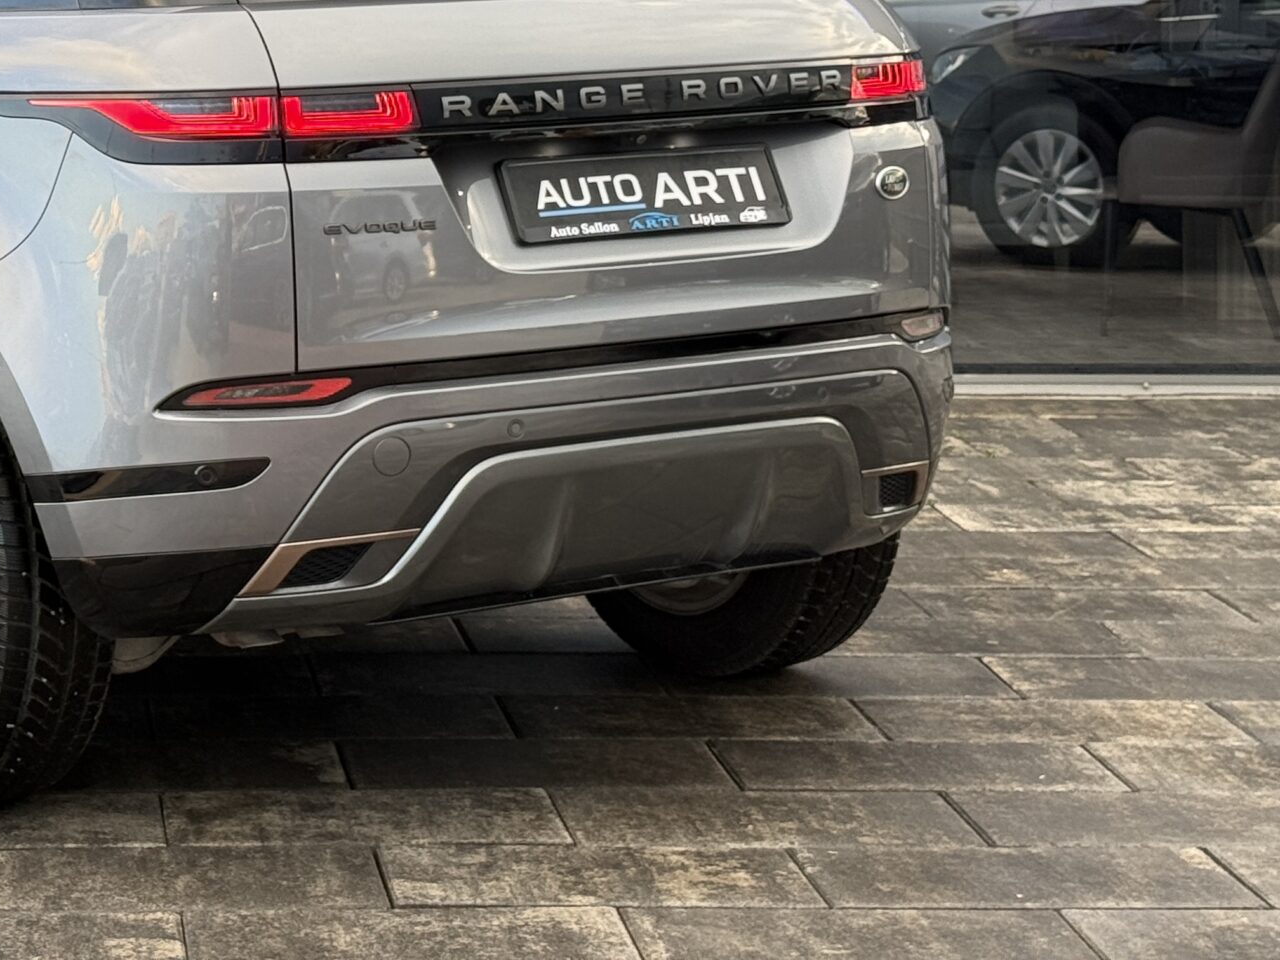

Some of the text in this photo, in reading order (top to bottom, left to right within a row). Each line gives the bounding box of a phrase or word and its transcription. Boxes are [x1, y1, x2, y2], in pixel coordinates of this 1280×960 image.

[440, 69, 843, 119] RANGE ROVER
[537, 166, 767, 210] AUTO ARTI
[323, 219, 438, 236] EVOQUE
[630, 214, 680, 230] ARTI
[690, 213, 730, 227] Lipjan
[550, 225, 580, 238] Auto
